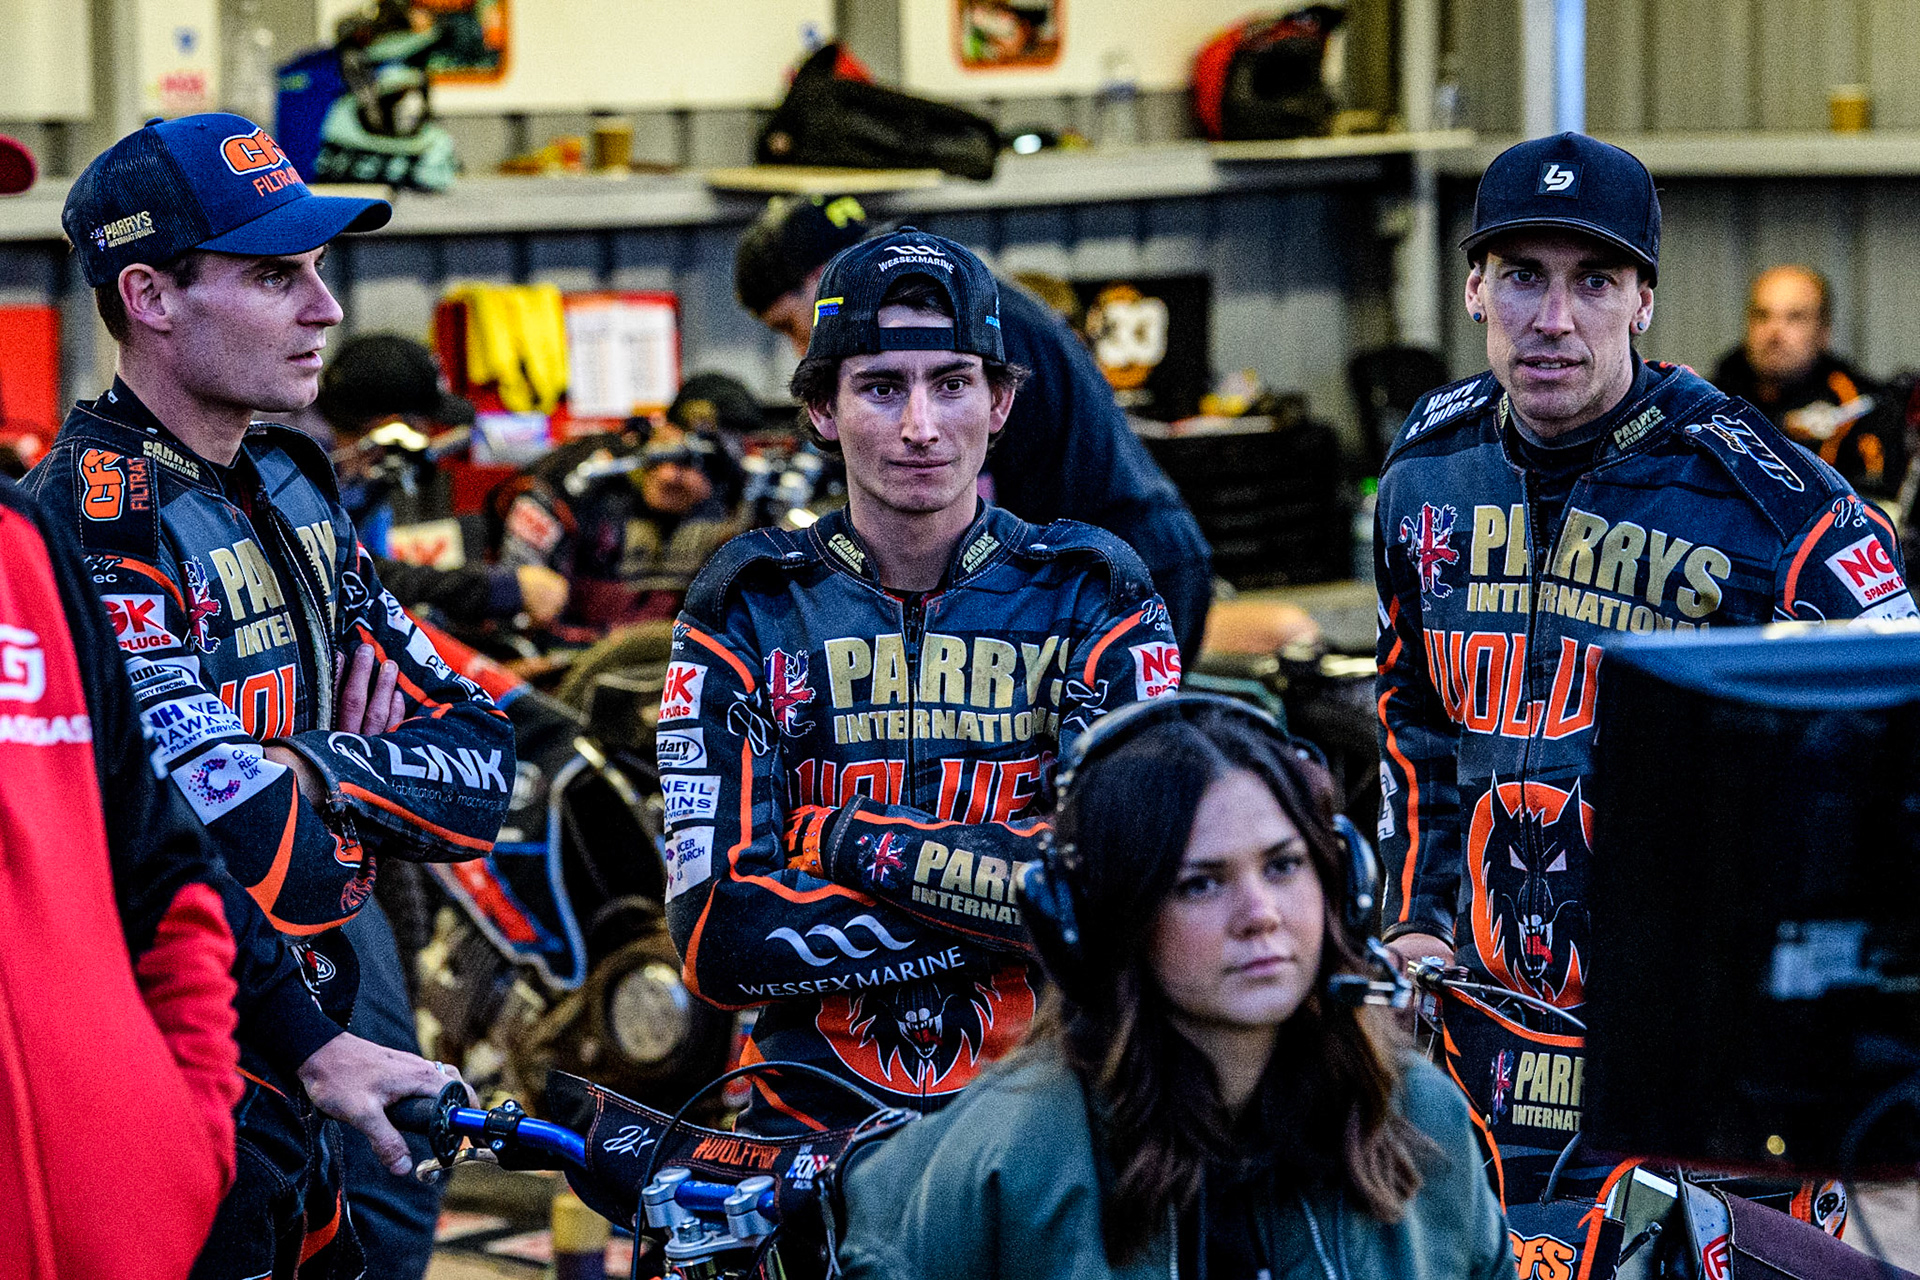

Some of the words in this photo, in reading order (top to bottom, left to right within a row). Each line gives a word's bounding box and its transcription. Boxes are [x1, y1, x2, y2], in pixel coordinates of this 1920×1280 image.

[103, 211, 153, 240] PARRYS
[107, 227, 156, 248] INTERNATIONAL
[1423, 380, 1481, 415] Harry
[1405, 421, 1420, 440] &
[1420, 398, 1471, 432] Jules
[1864, 578, 1899, 601] SPARK
[170, 732, 202, 753] PLANT
[244, 765, 262, 780] UK
[380, 738, 508, 793] LINK
